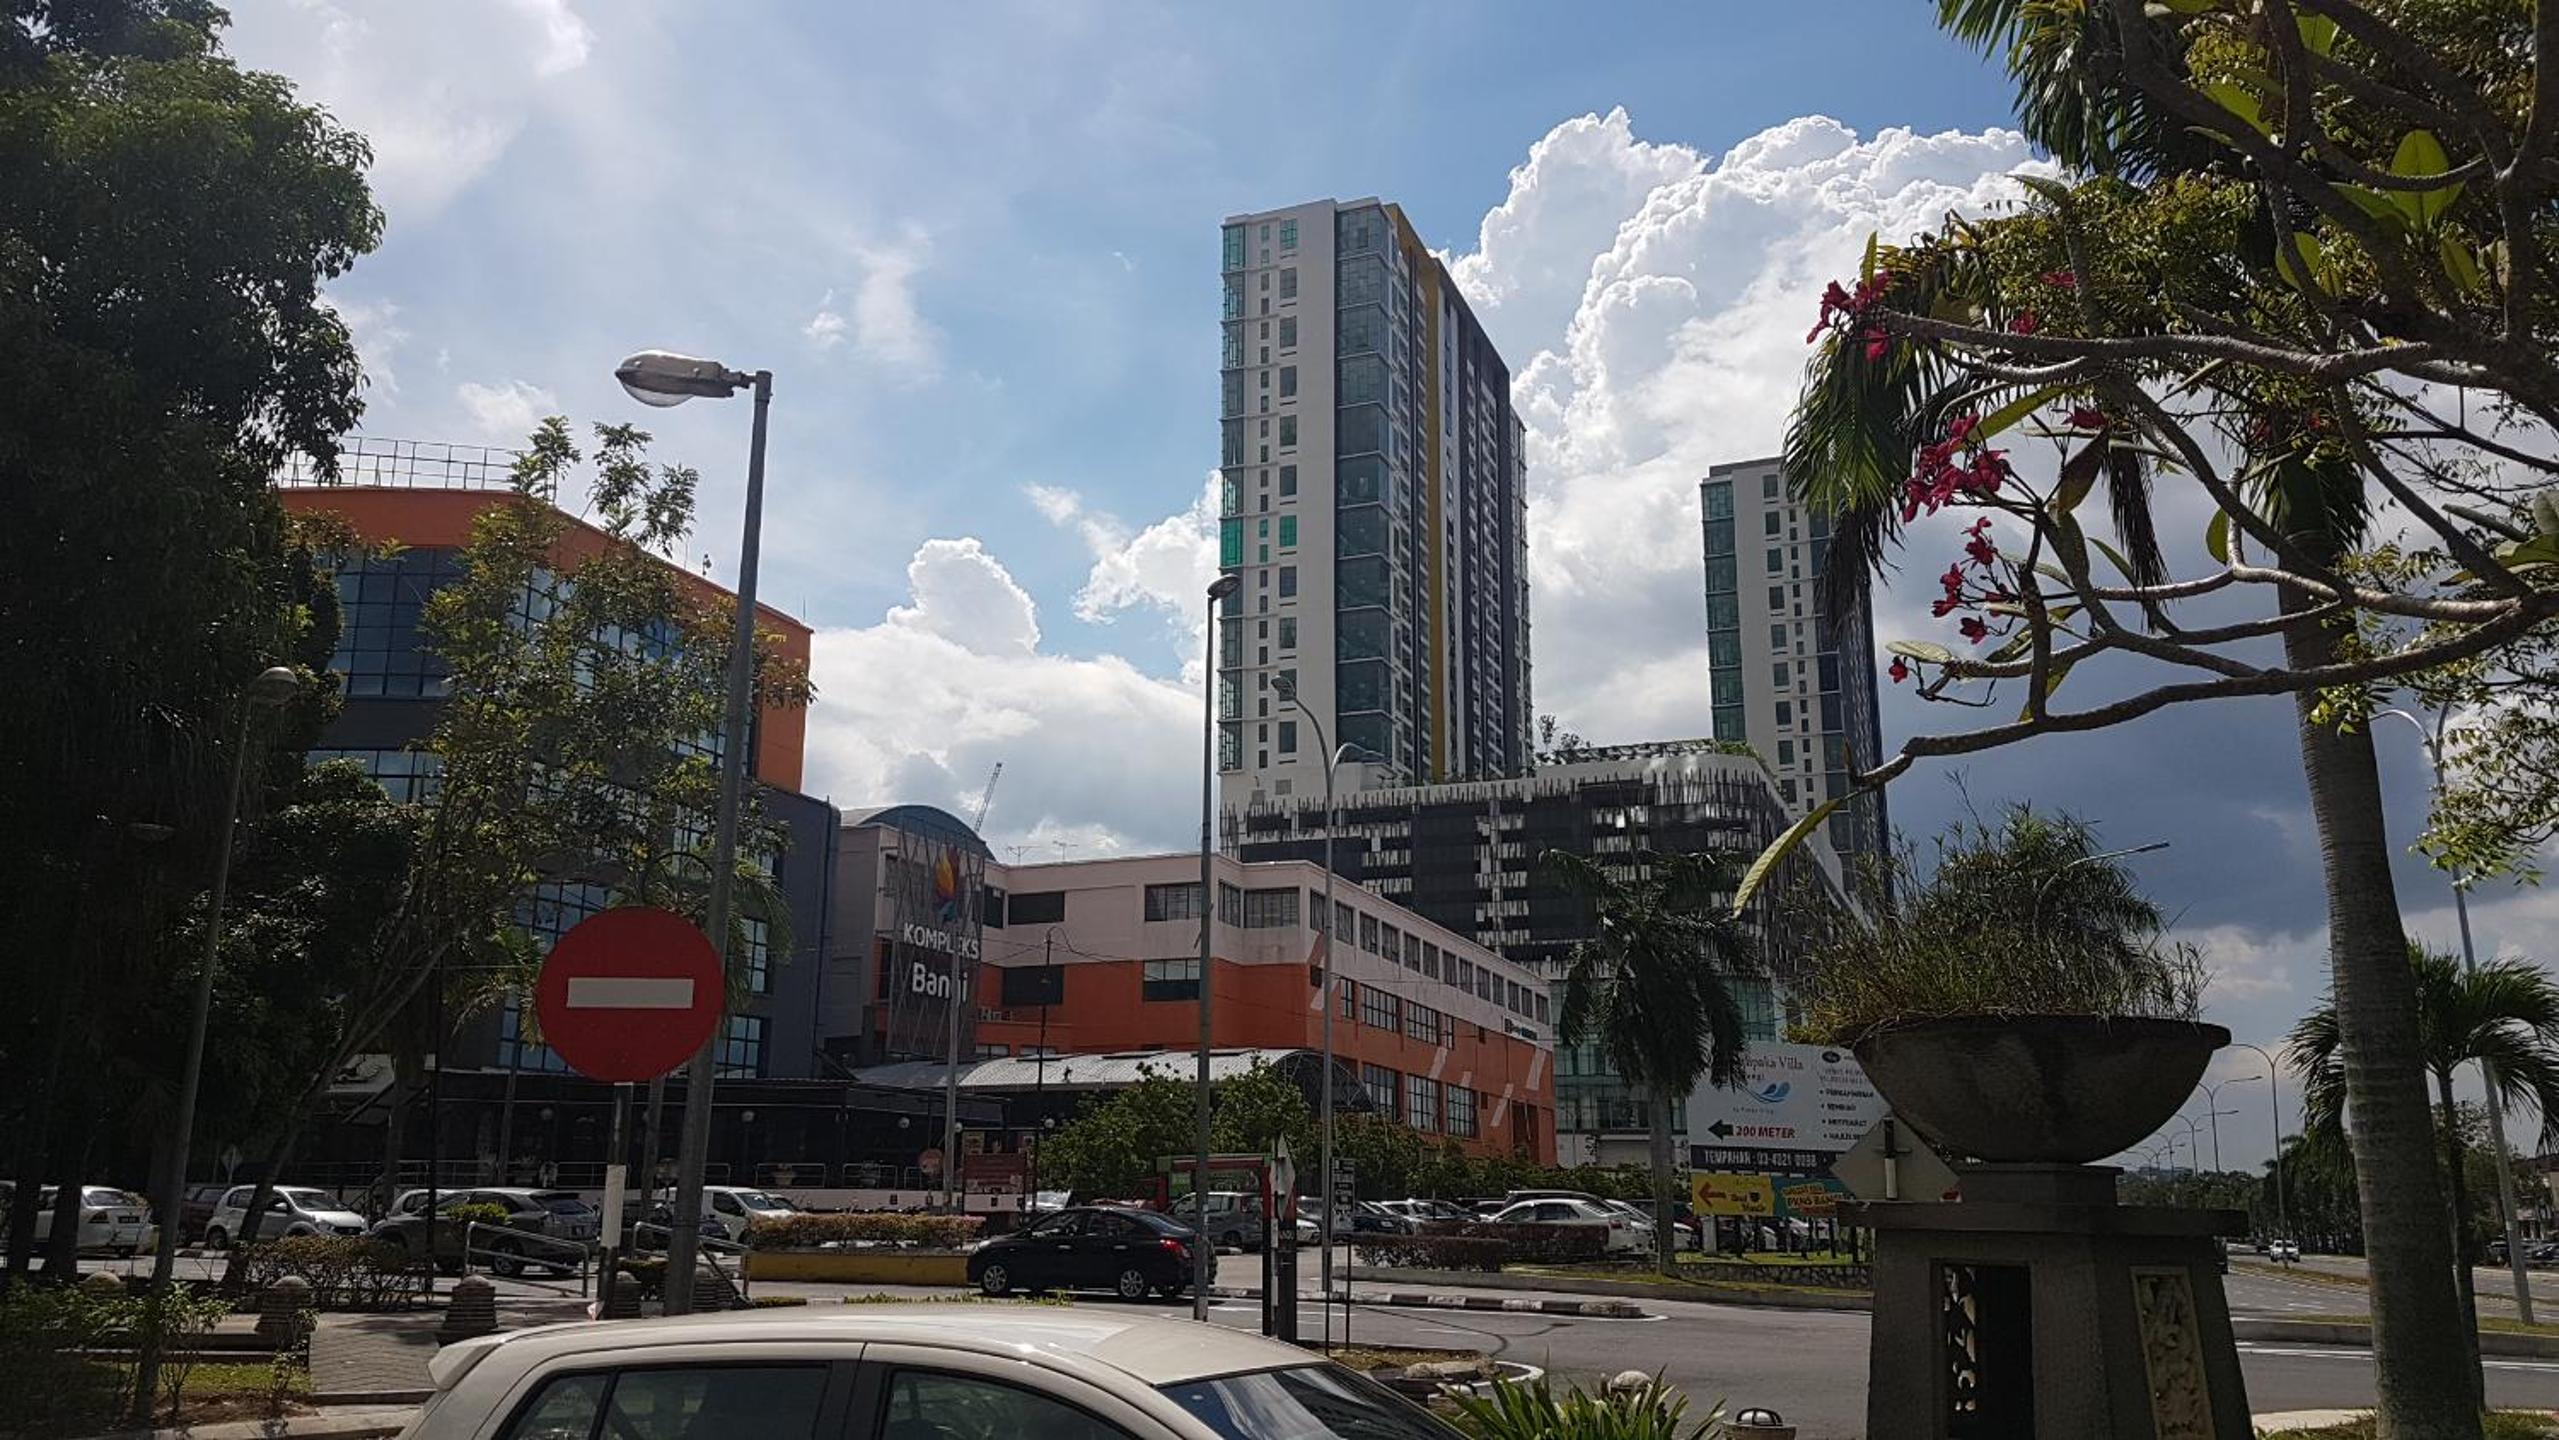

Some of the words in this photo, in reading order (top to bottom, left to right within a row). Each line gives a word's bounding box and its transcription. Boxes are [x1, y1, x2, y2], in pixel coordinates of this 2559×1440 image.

[1779, 1056, 1804, 1070] Villa
[1735, 1125, 1757, 1138] 200
[1757, 1126, 1796, 1139] METER
